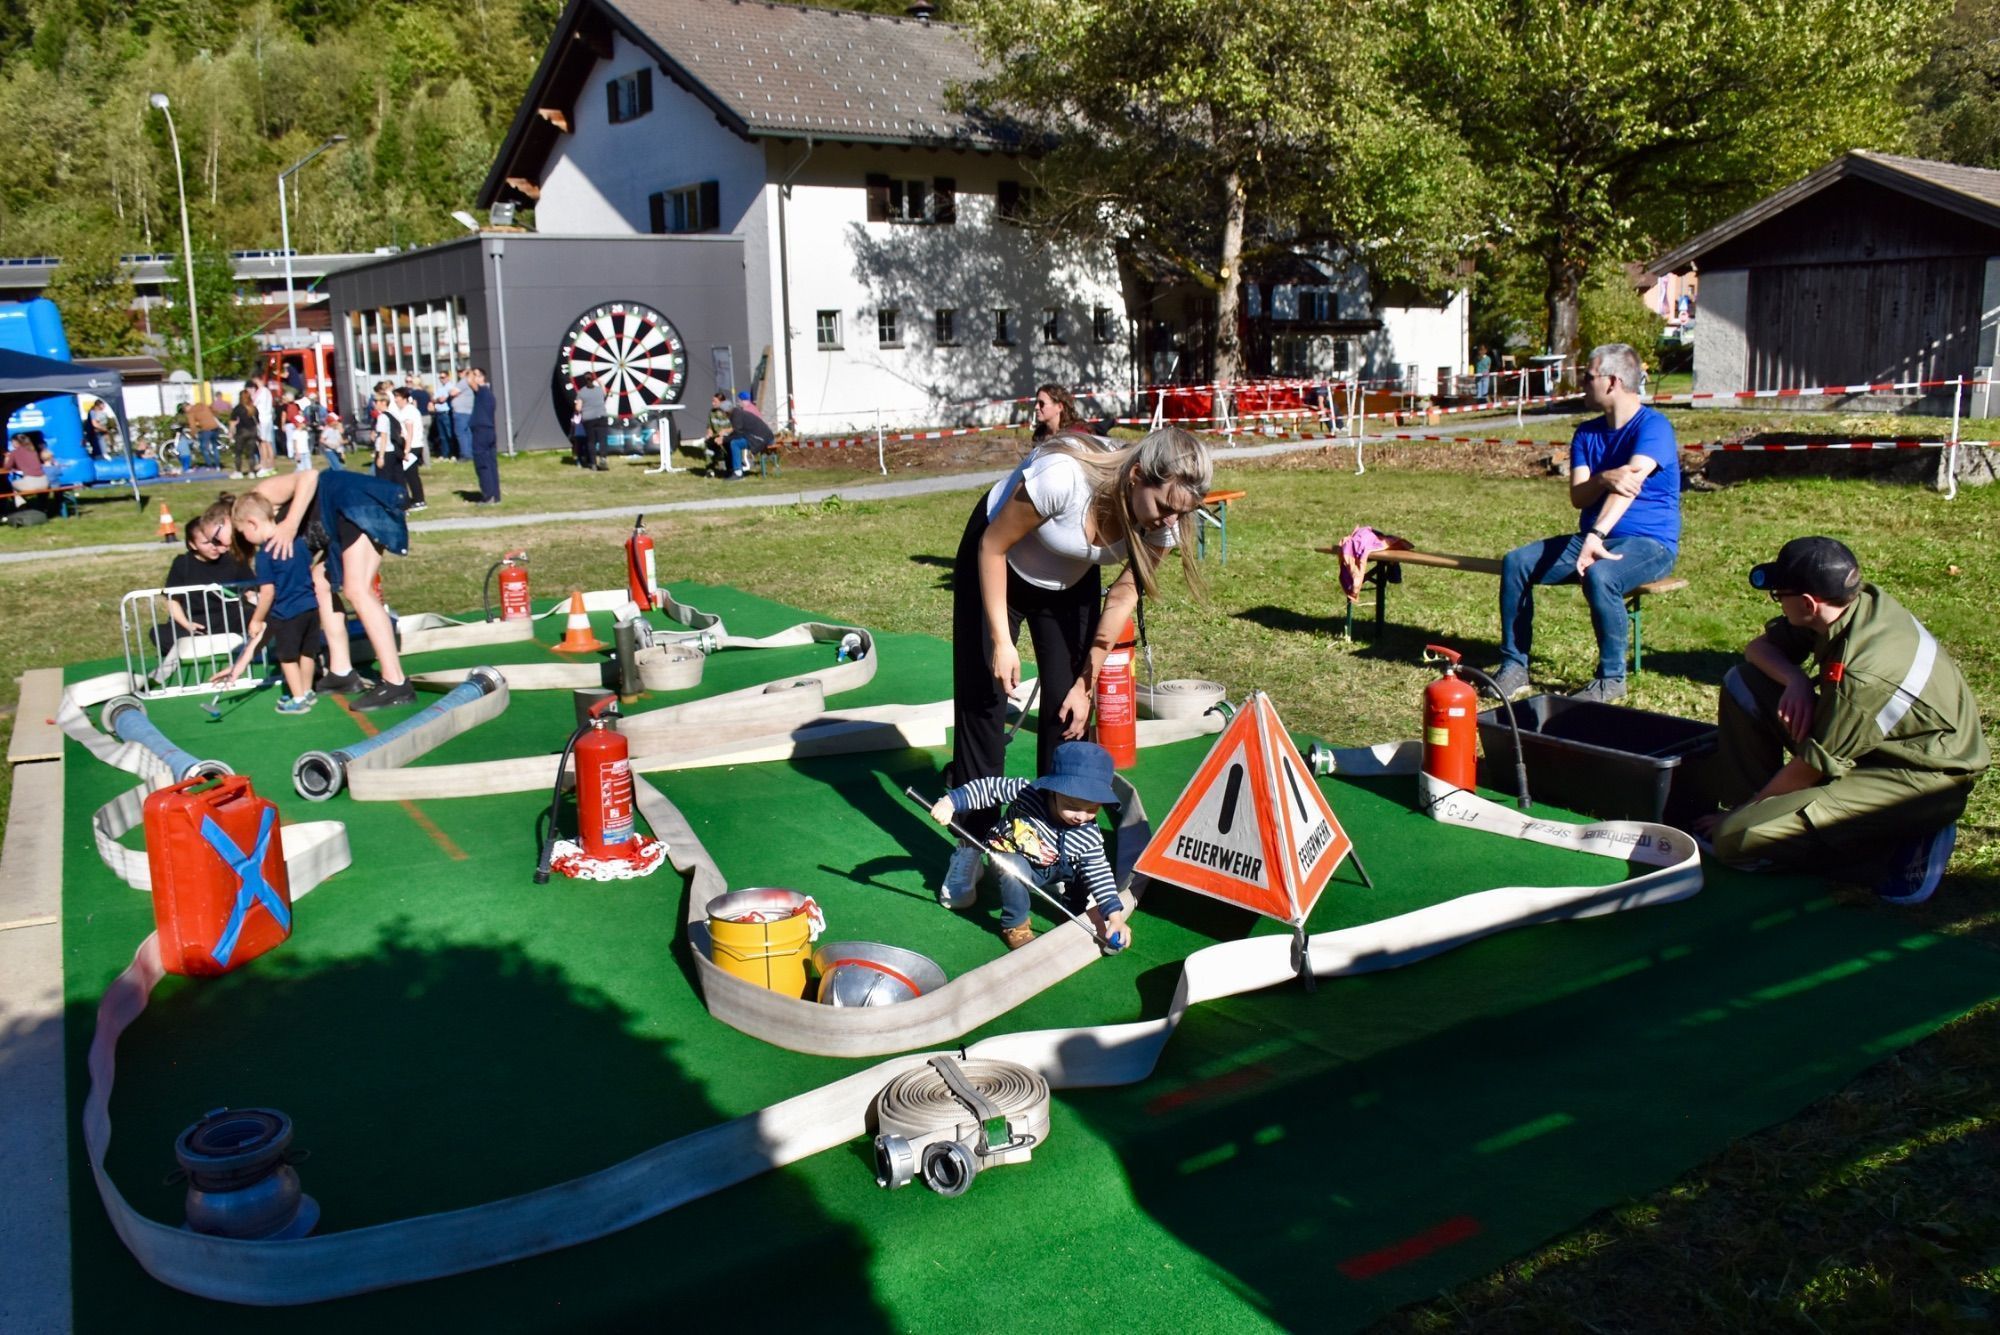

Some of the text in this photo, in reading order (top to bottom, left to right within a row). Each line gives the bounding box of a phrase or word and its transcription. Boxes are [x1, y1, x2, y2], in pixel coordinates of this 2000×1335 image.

[612, 304, 624, 313] 20
[1175, 834, 1263, 882] FEUERWEHR
[1298, 818, 1333, 873] FEUERWEHR
